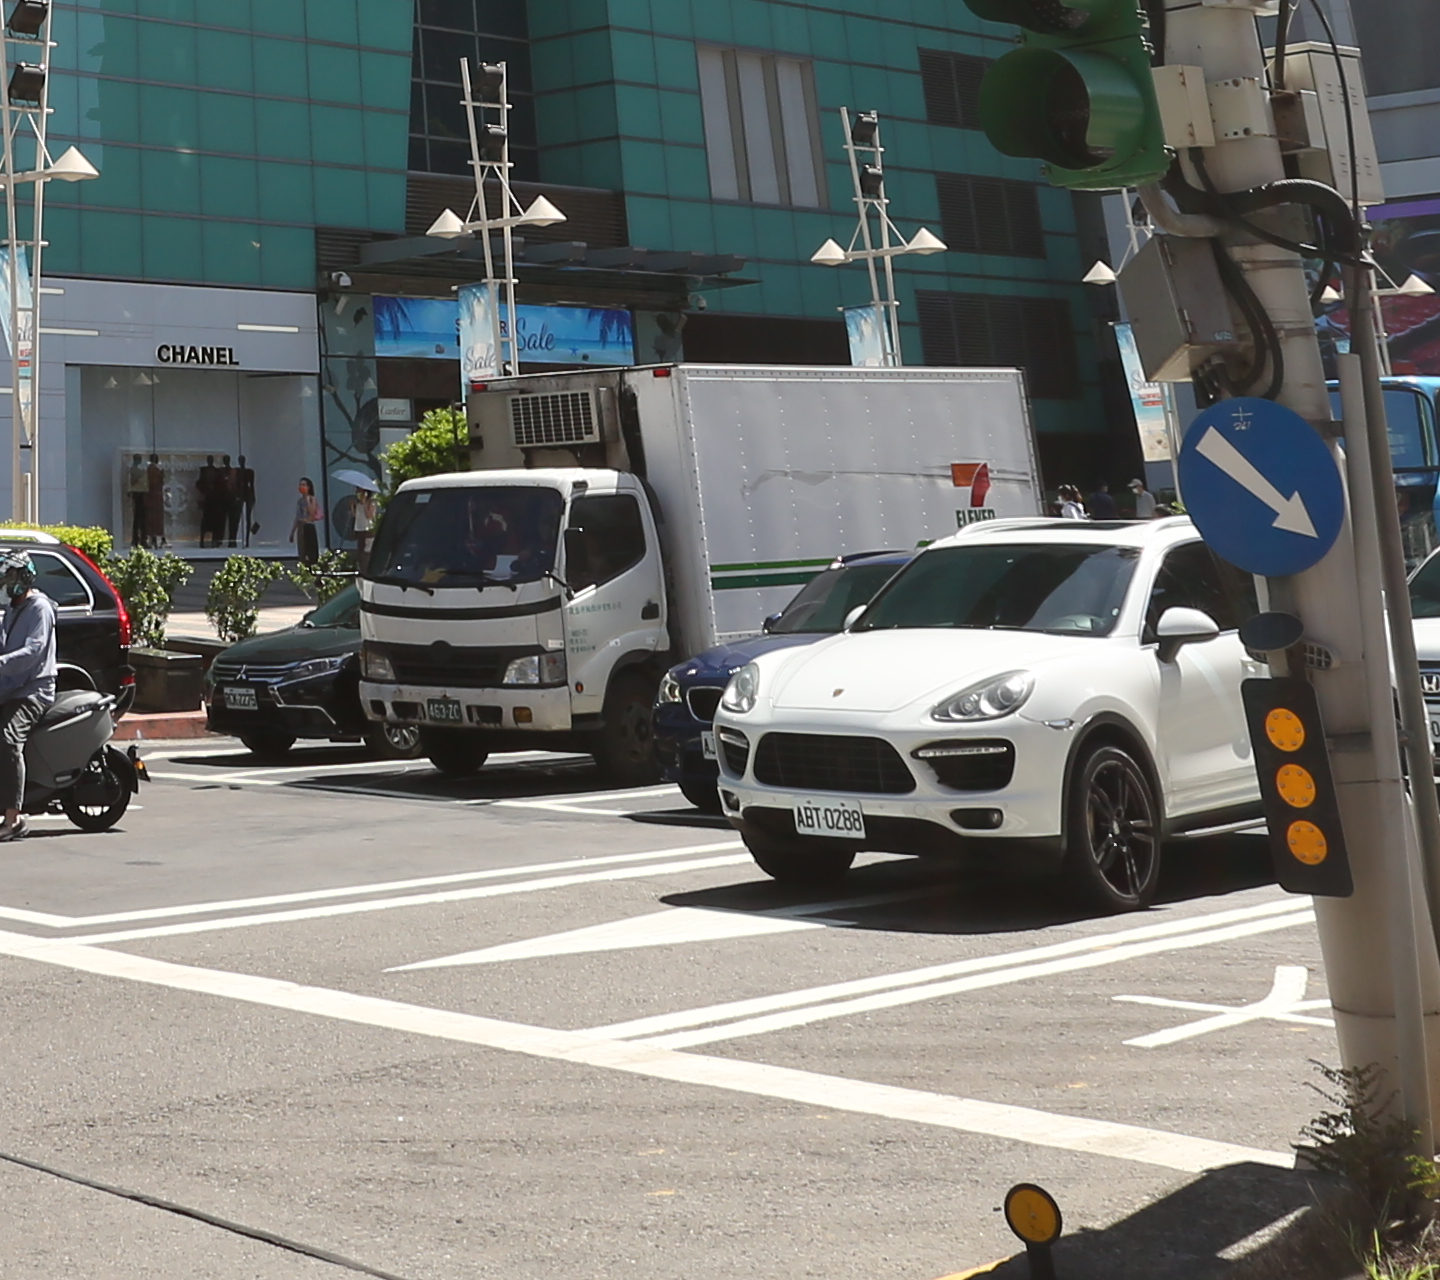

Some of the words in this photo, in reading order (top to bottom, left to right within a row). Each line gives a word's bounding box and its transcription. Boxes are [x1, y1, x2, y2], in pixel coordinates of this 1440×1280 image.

[515, 317, 557, 352] Sale
[156, 343, 240, 367] CHANEL
[796, 805, 863, 833] ABT-0288
